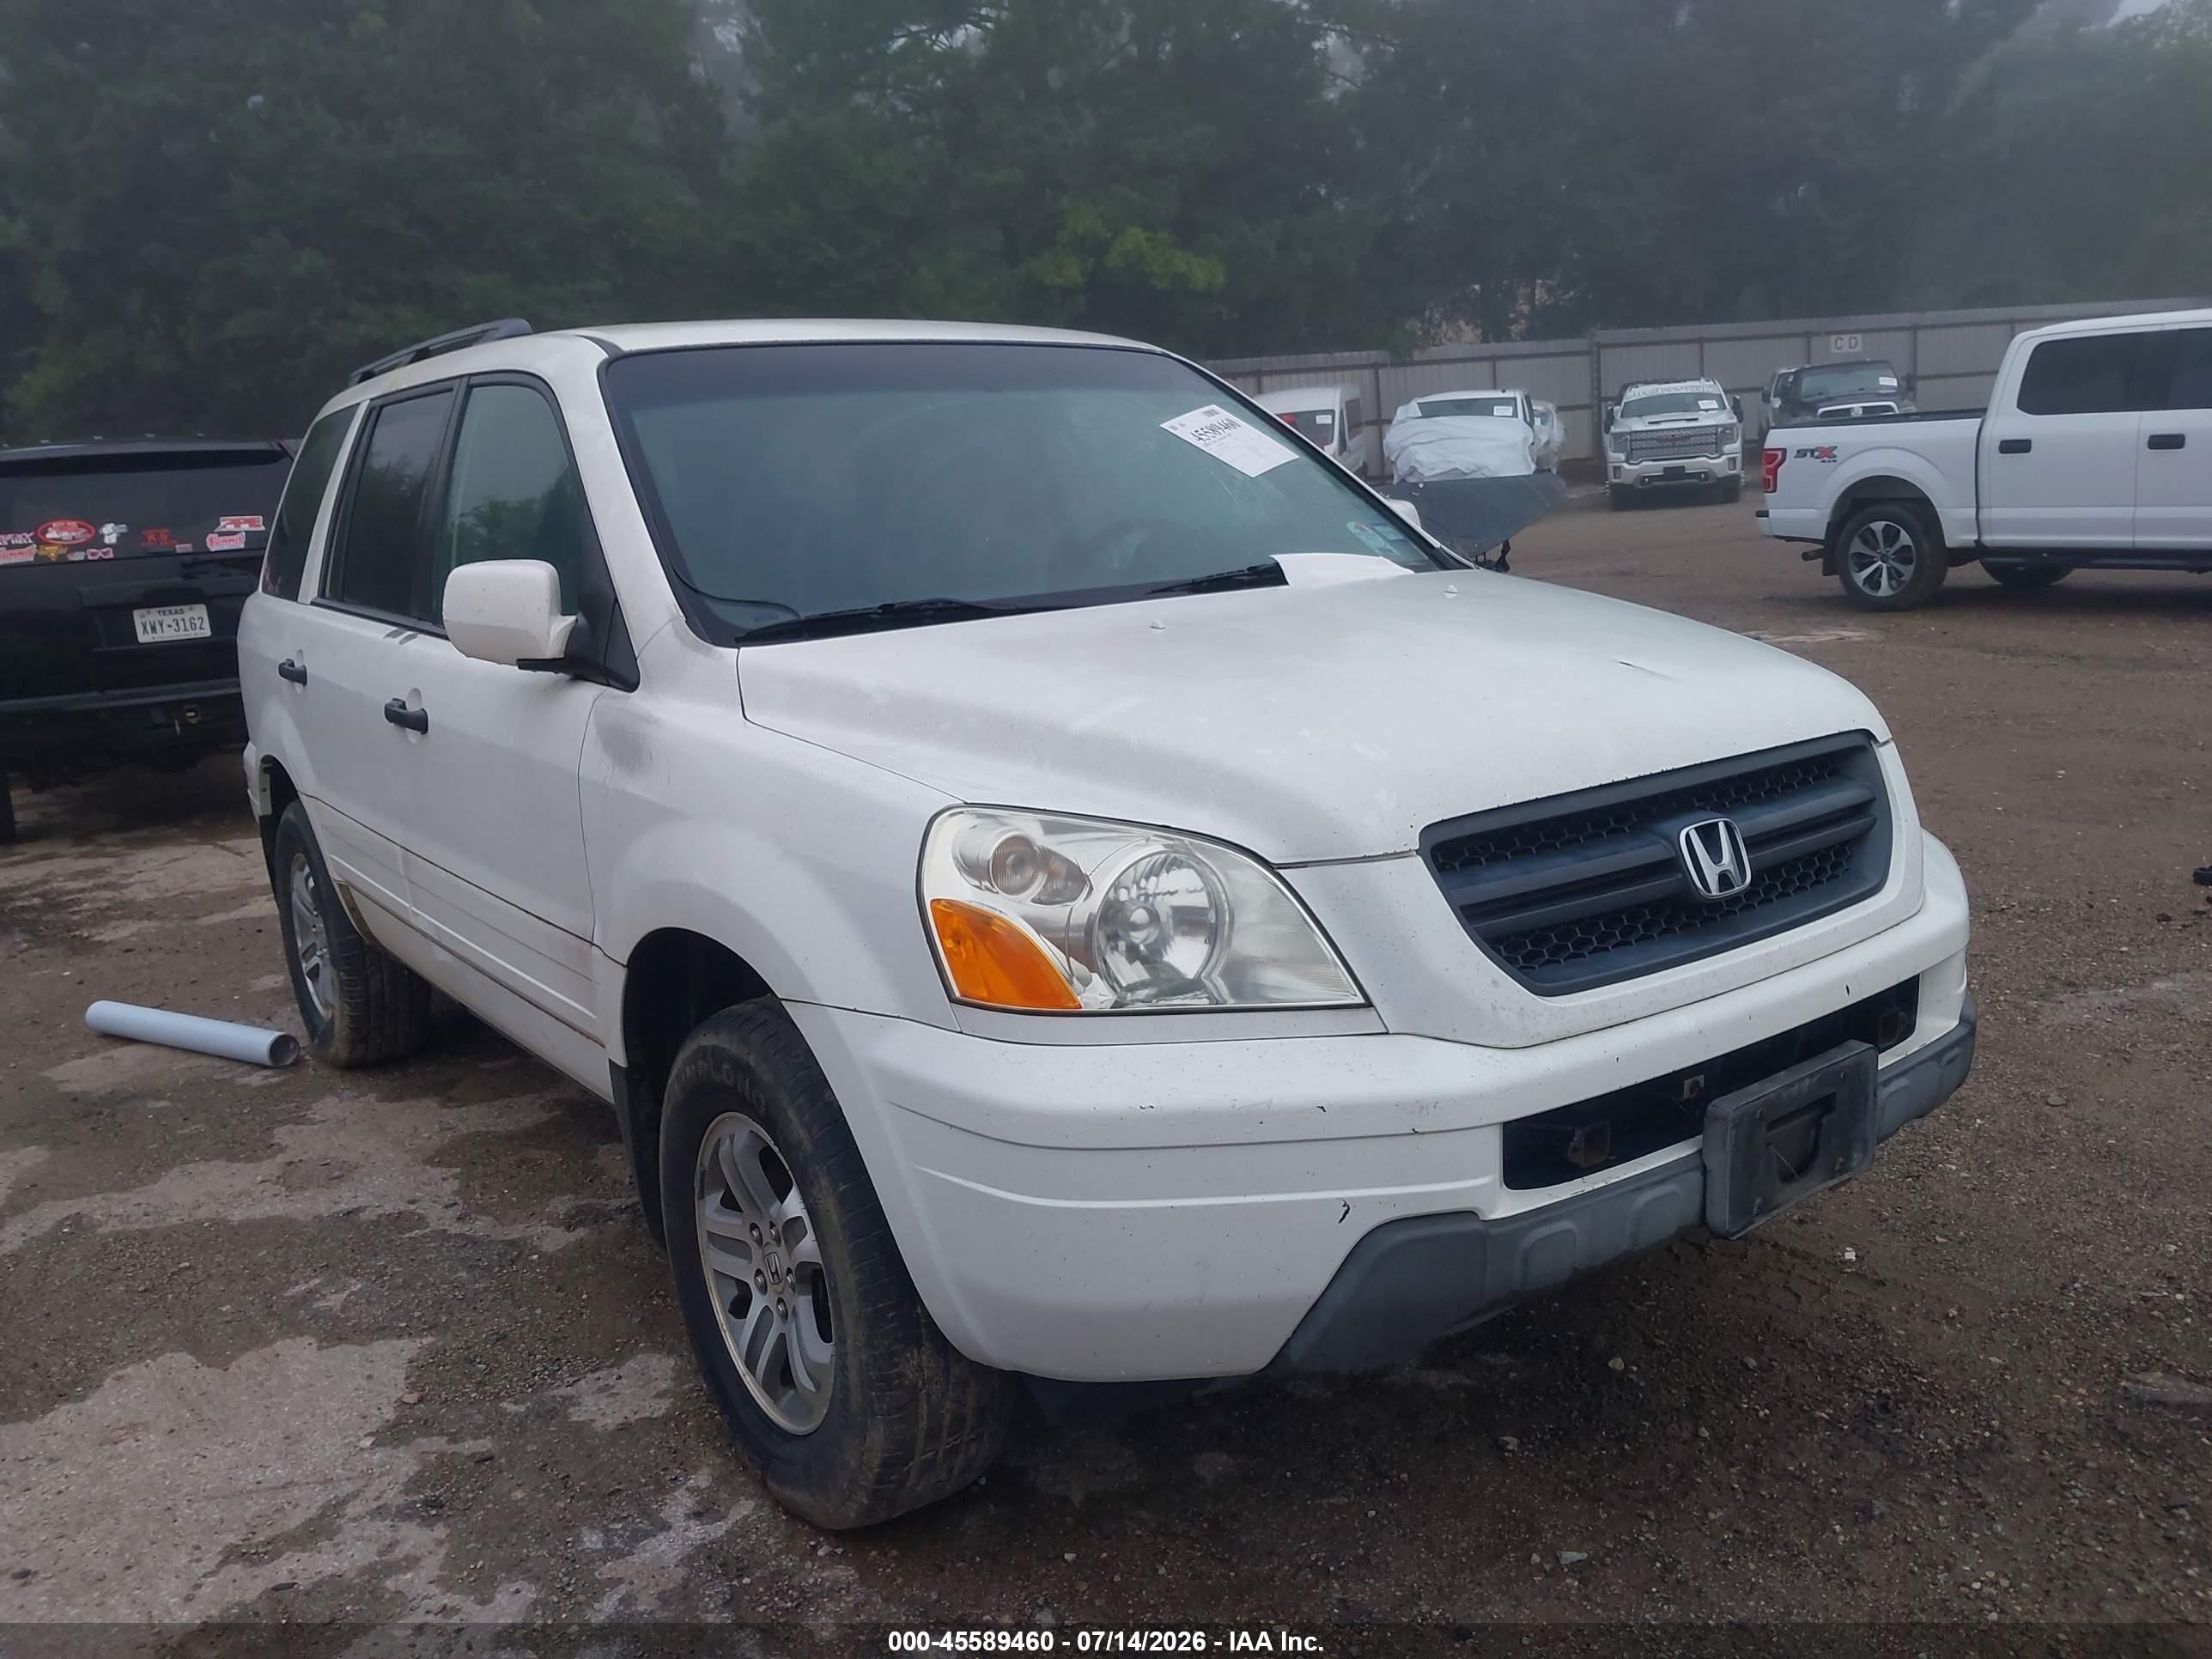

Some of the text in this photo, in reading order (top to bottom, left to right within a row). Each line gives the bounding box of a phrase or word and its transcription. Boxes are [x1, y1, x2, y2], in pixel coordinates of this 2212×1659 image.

[1190, 418, 1242, 442] 45589460
[1793, 446, 1838, 459] STX
[157, 608, 185, 617] TEXAS
